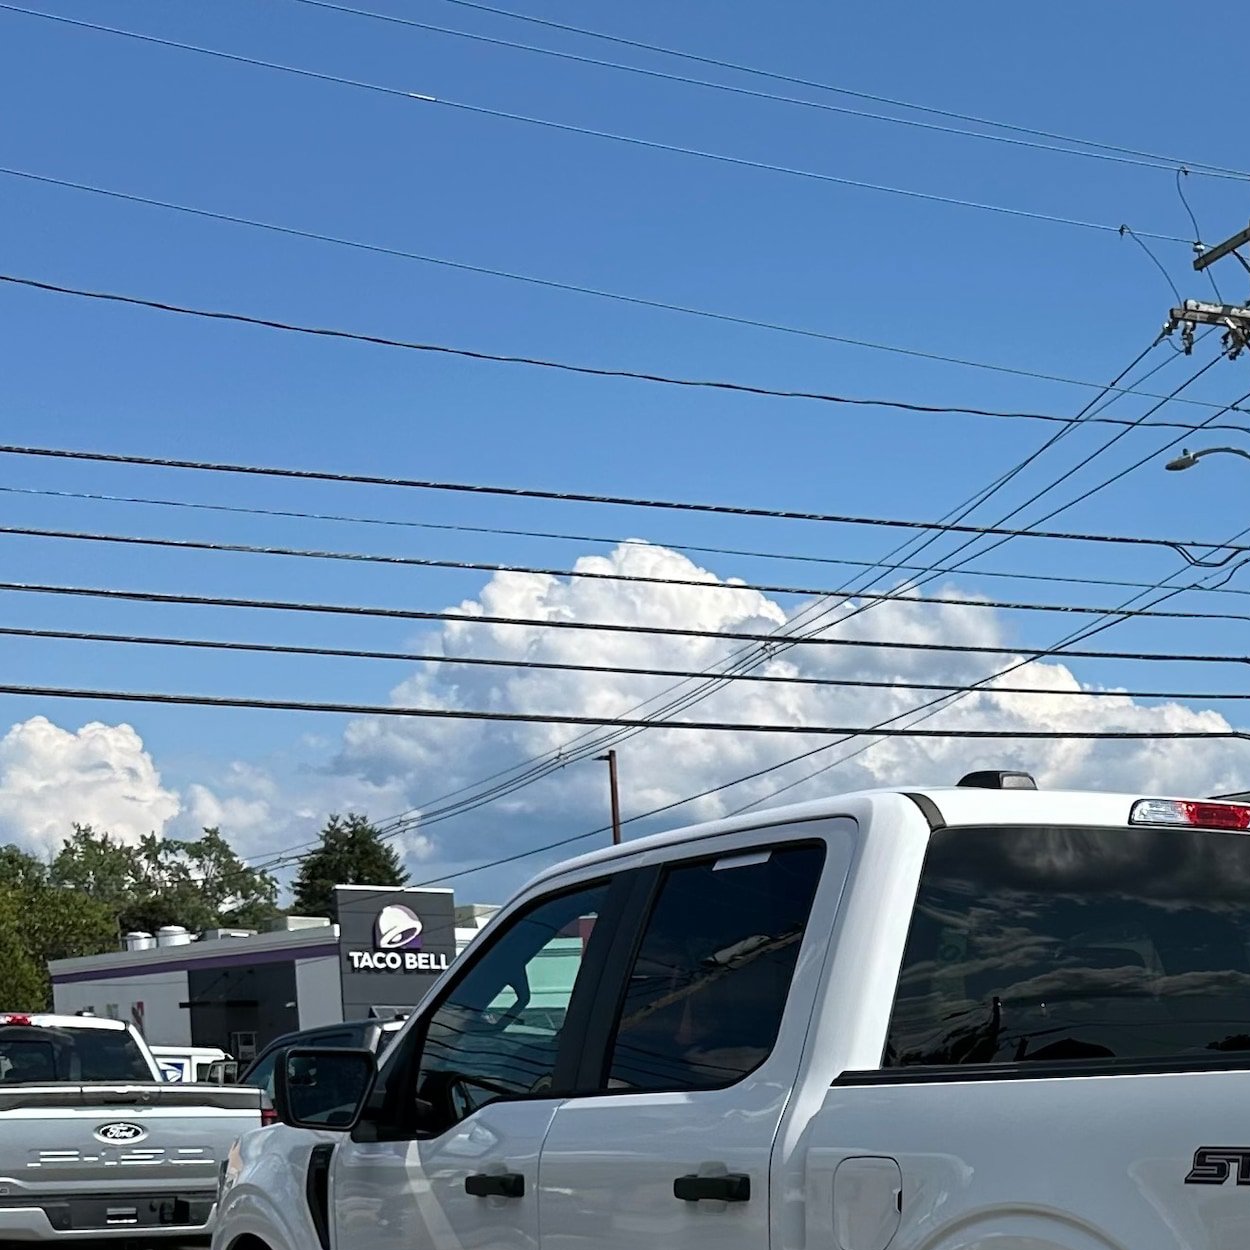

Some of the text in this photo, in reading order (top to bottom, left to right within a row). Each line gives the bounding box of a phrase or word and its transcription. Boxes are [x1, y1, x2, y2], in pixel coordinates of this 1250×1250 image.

[348, 951, 450, 970] TACO BELL
[106, 1126, 135, 1138] Ford
